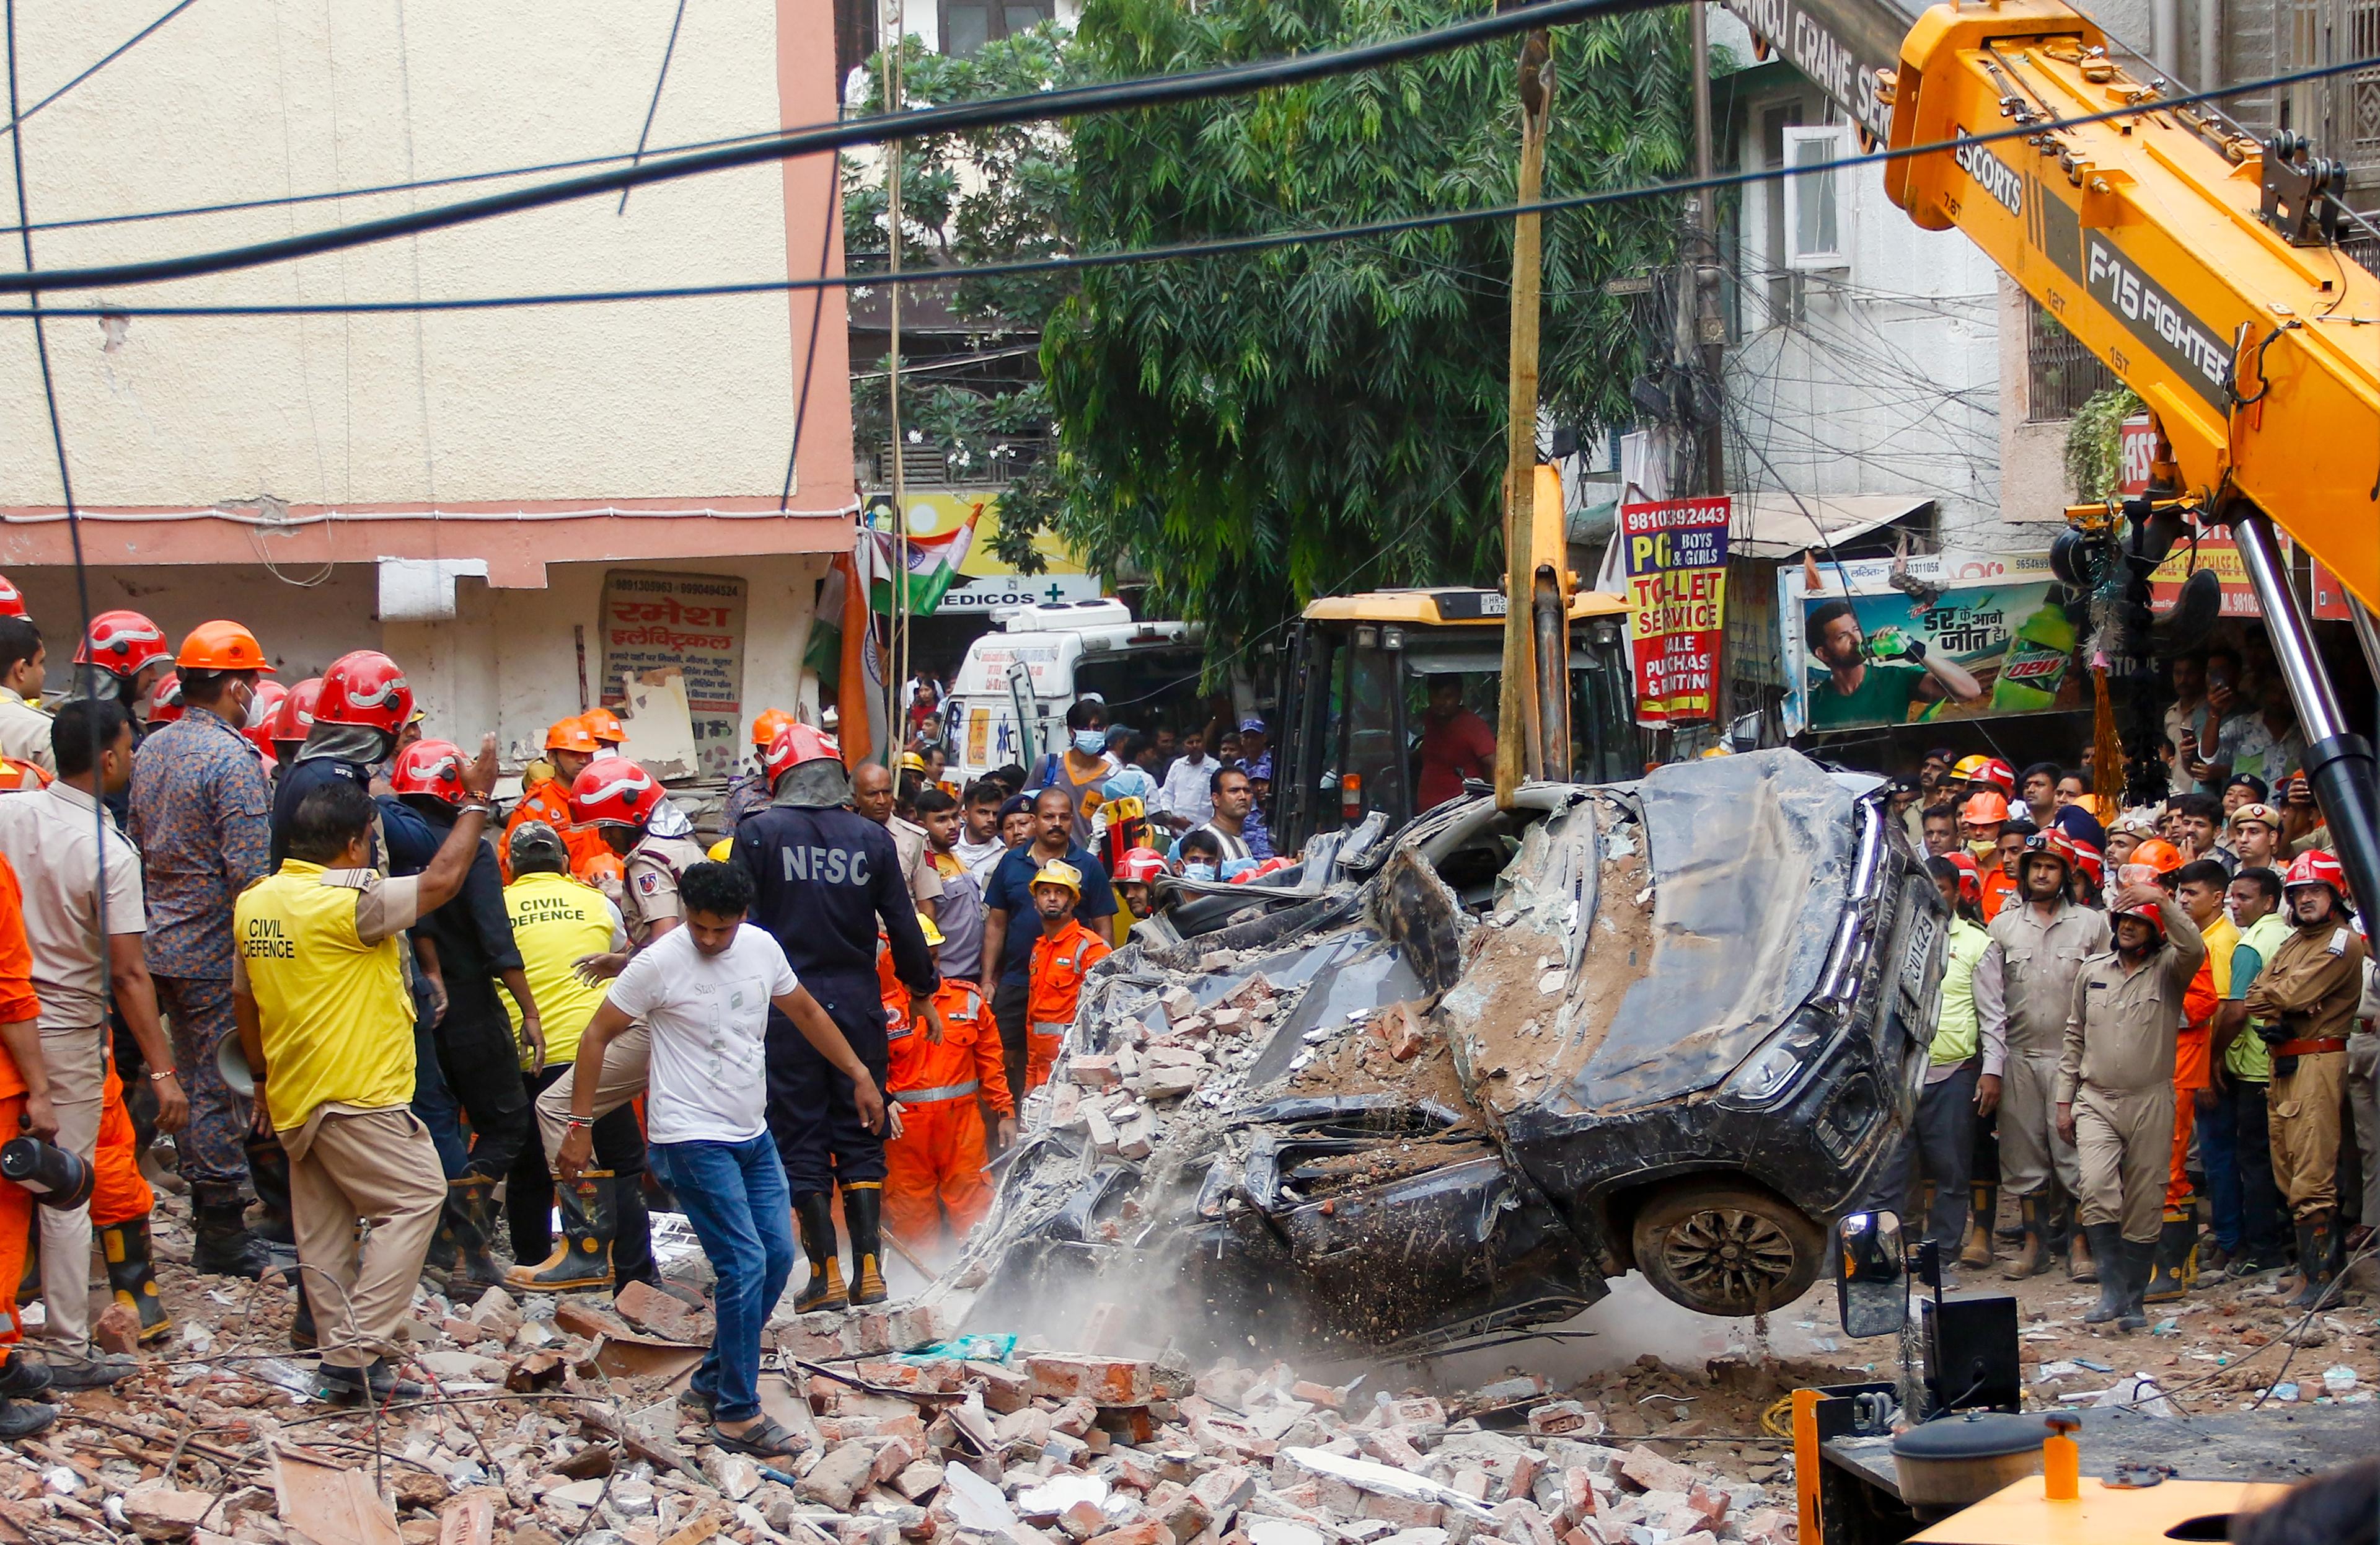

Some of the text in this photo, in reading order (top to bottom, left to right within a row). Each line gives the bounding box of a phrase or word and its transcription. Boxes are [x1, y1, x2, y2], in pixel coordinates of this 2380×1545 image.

[1794, 11, 1853, 106] CRANE
[1954, 126, 2022, 217] ESCORTS
[2089, 241, 2140, 321] F15
[2047, 288, 2066, 316] 12T
[2109, 346, 2130, 376] 15T
[1628, 507, 1725, 530] 9810392443
[1632, 533, 1713, 572] PG BOYS
[1672, 549, 1718, 566] & GIRLS
[2184, 556, 2232, 575] PRCHASE
[1633, 573, 1722, 607] TO-LET
[611, 596, 731, 627] रमेश
[1639, 604, 1717, 634] SERVICE
[1923, 605, 2004, 631] डर के आगे
[1939, 623, 1990, 652] जीत
[1646, 653, 1711, 678] PUCHAS
[2106, 655, 2159, 678] STOE
[1649, 673, 1711, 696] & RNTIN
[782, 846, 871, 886] NFSC
[521, 898, 570, 911] CIVIL
[249, 919, 284, 938] CIVIL
[509, 910, 585, 929] DEFENCE
[244, 940, 295, 958] DEFENCE
[694, 983, 717, 996] Stay
